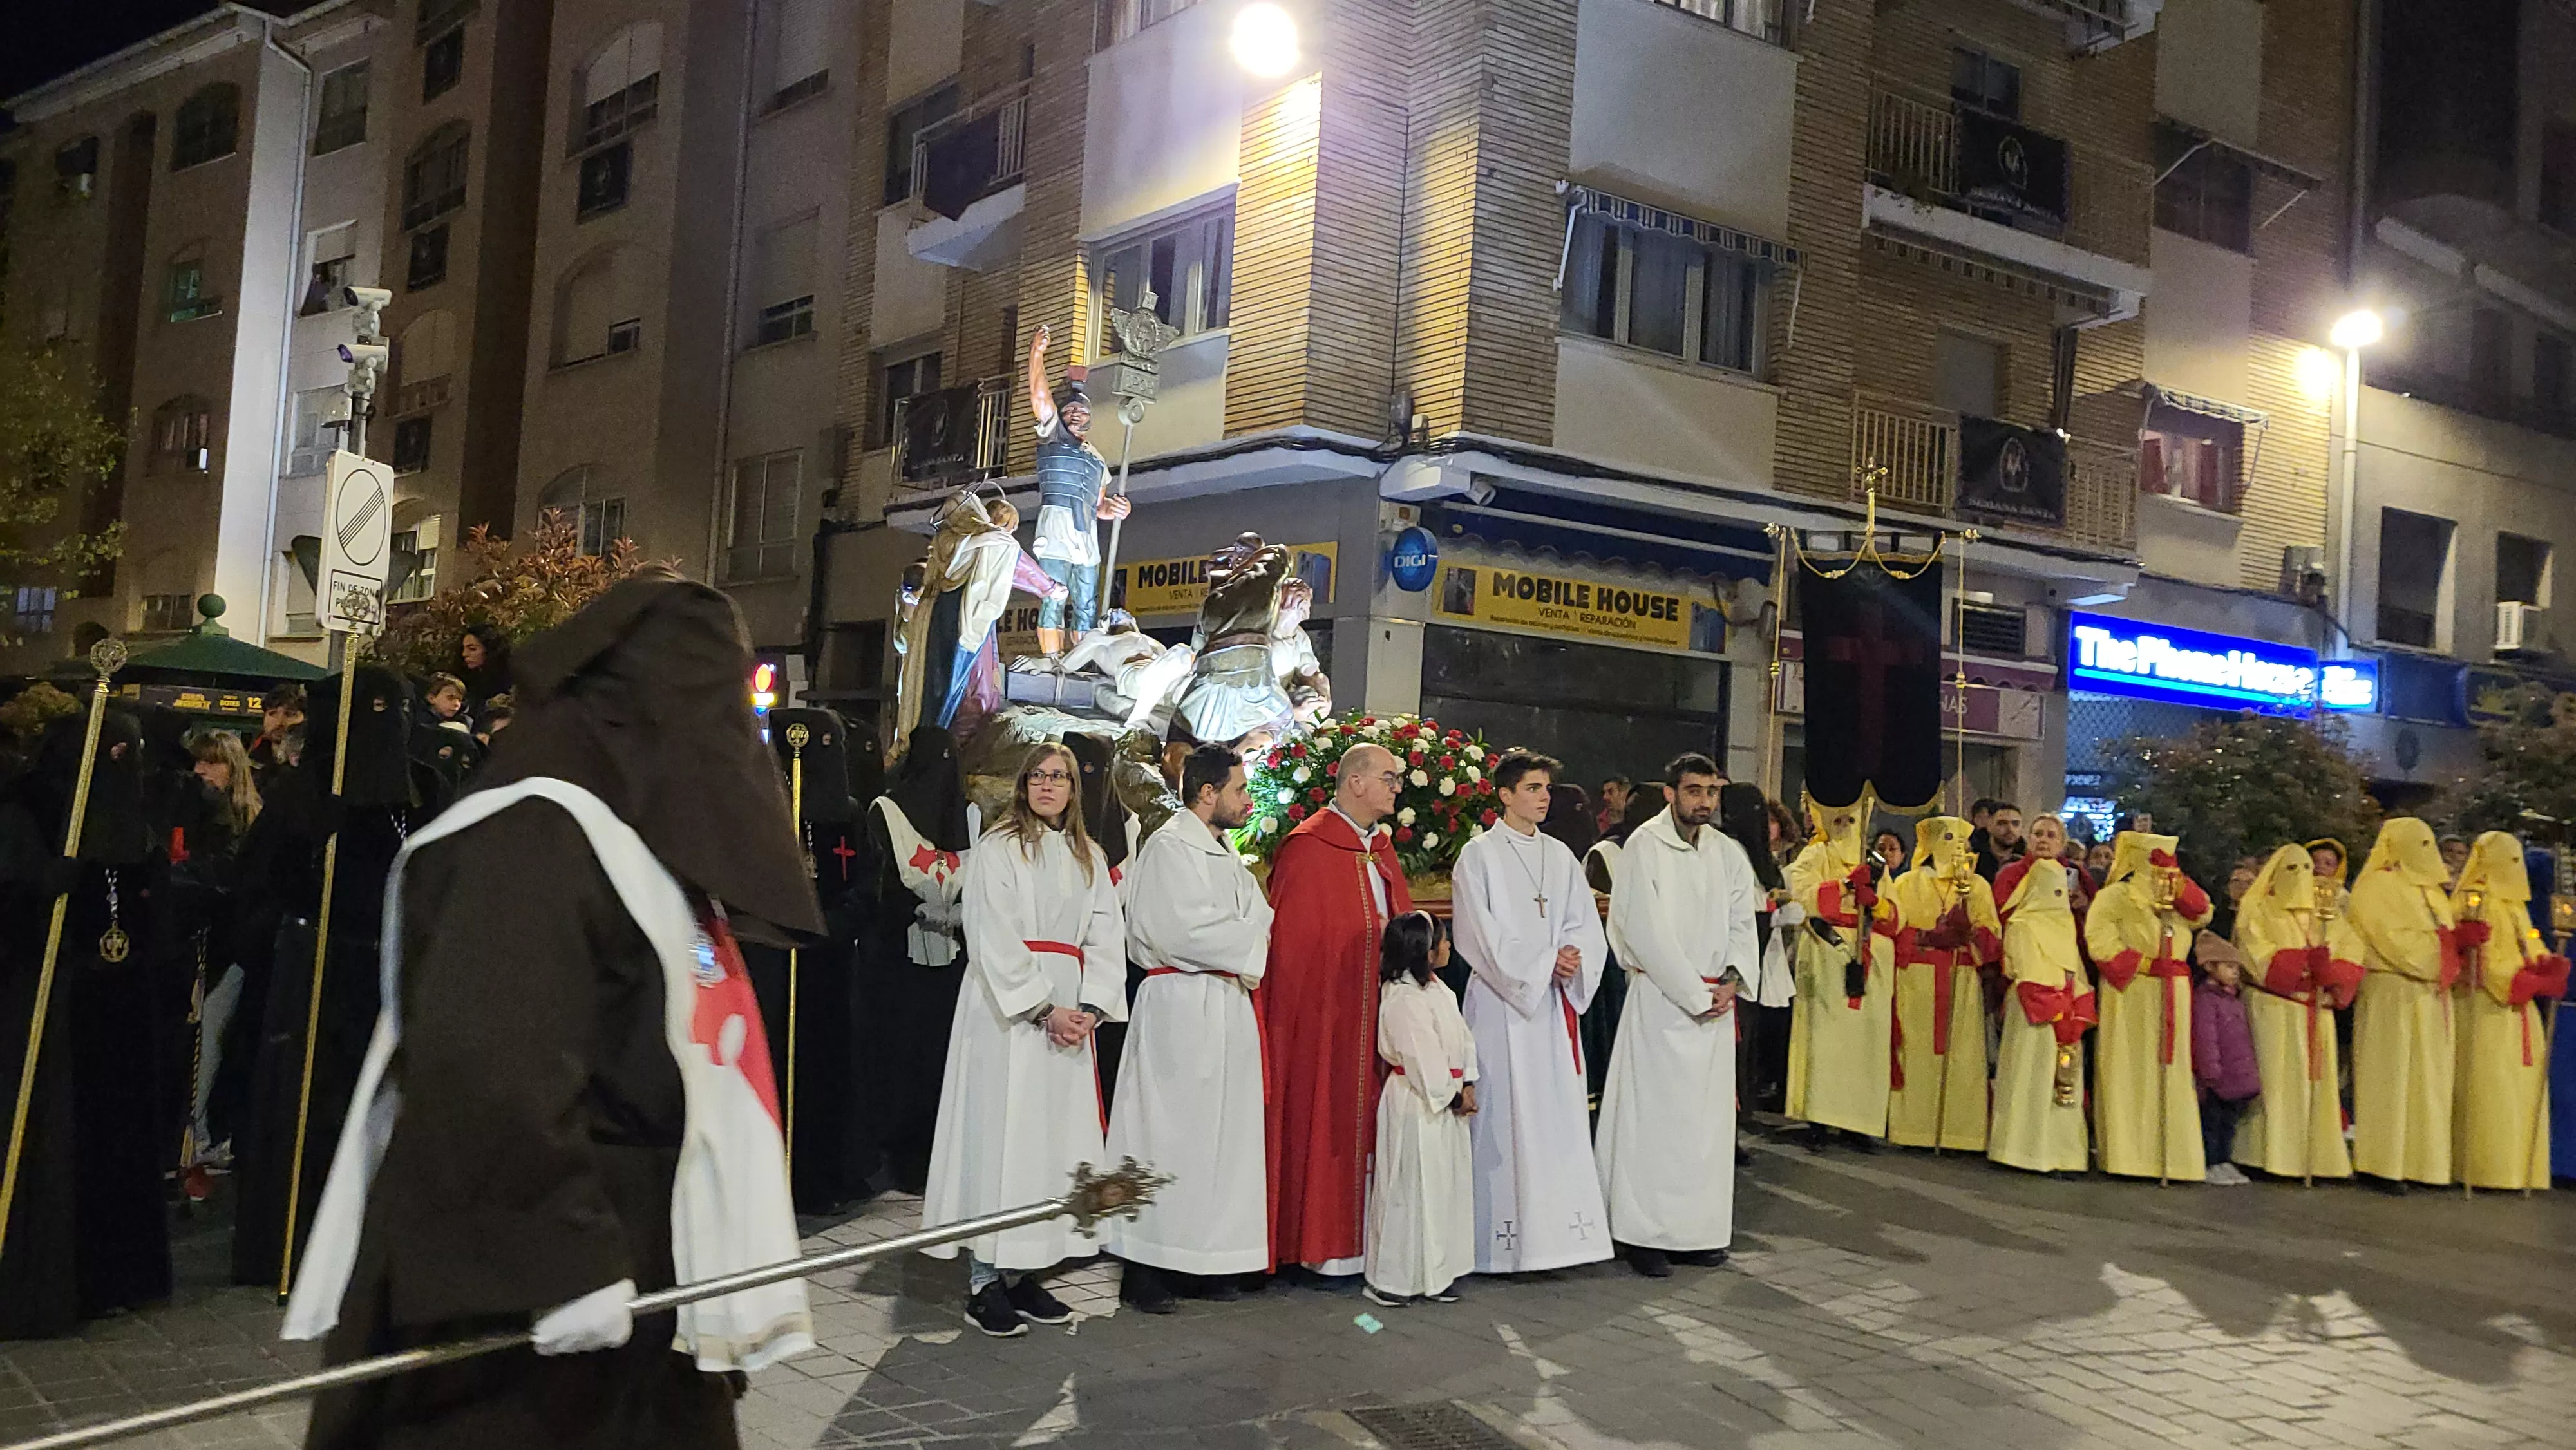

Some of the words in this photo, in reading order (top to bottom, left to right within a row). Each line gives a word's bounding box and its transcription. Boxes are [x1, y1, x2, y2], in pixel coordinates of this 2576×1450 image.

[1968, 498, 2018, 513] SEMANA
[2020, 504, 2056, 520] SANTA
[1394, 554, 1426, 568] DIGI
[1138, 559, 1209, 588] MOBILE
[333, 581, 346, 592] FIN
[348, 583, 358, 593] DE
[1170, 589, 1193, 599] VENTA
[1492, 571, 1591, 609] MOBILE
[1597, 587, 1680, 622] HOUSE
[1538, 607, 1570, 620] VENTA
[2075, 626, 2137, 673] The
[2137, 635, 2229, 686] Phone
[2226, 650, 2315, 695] House
